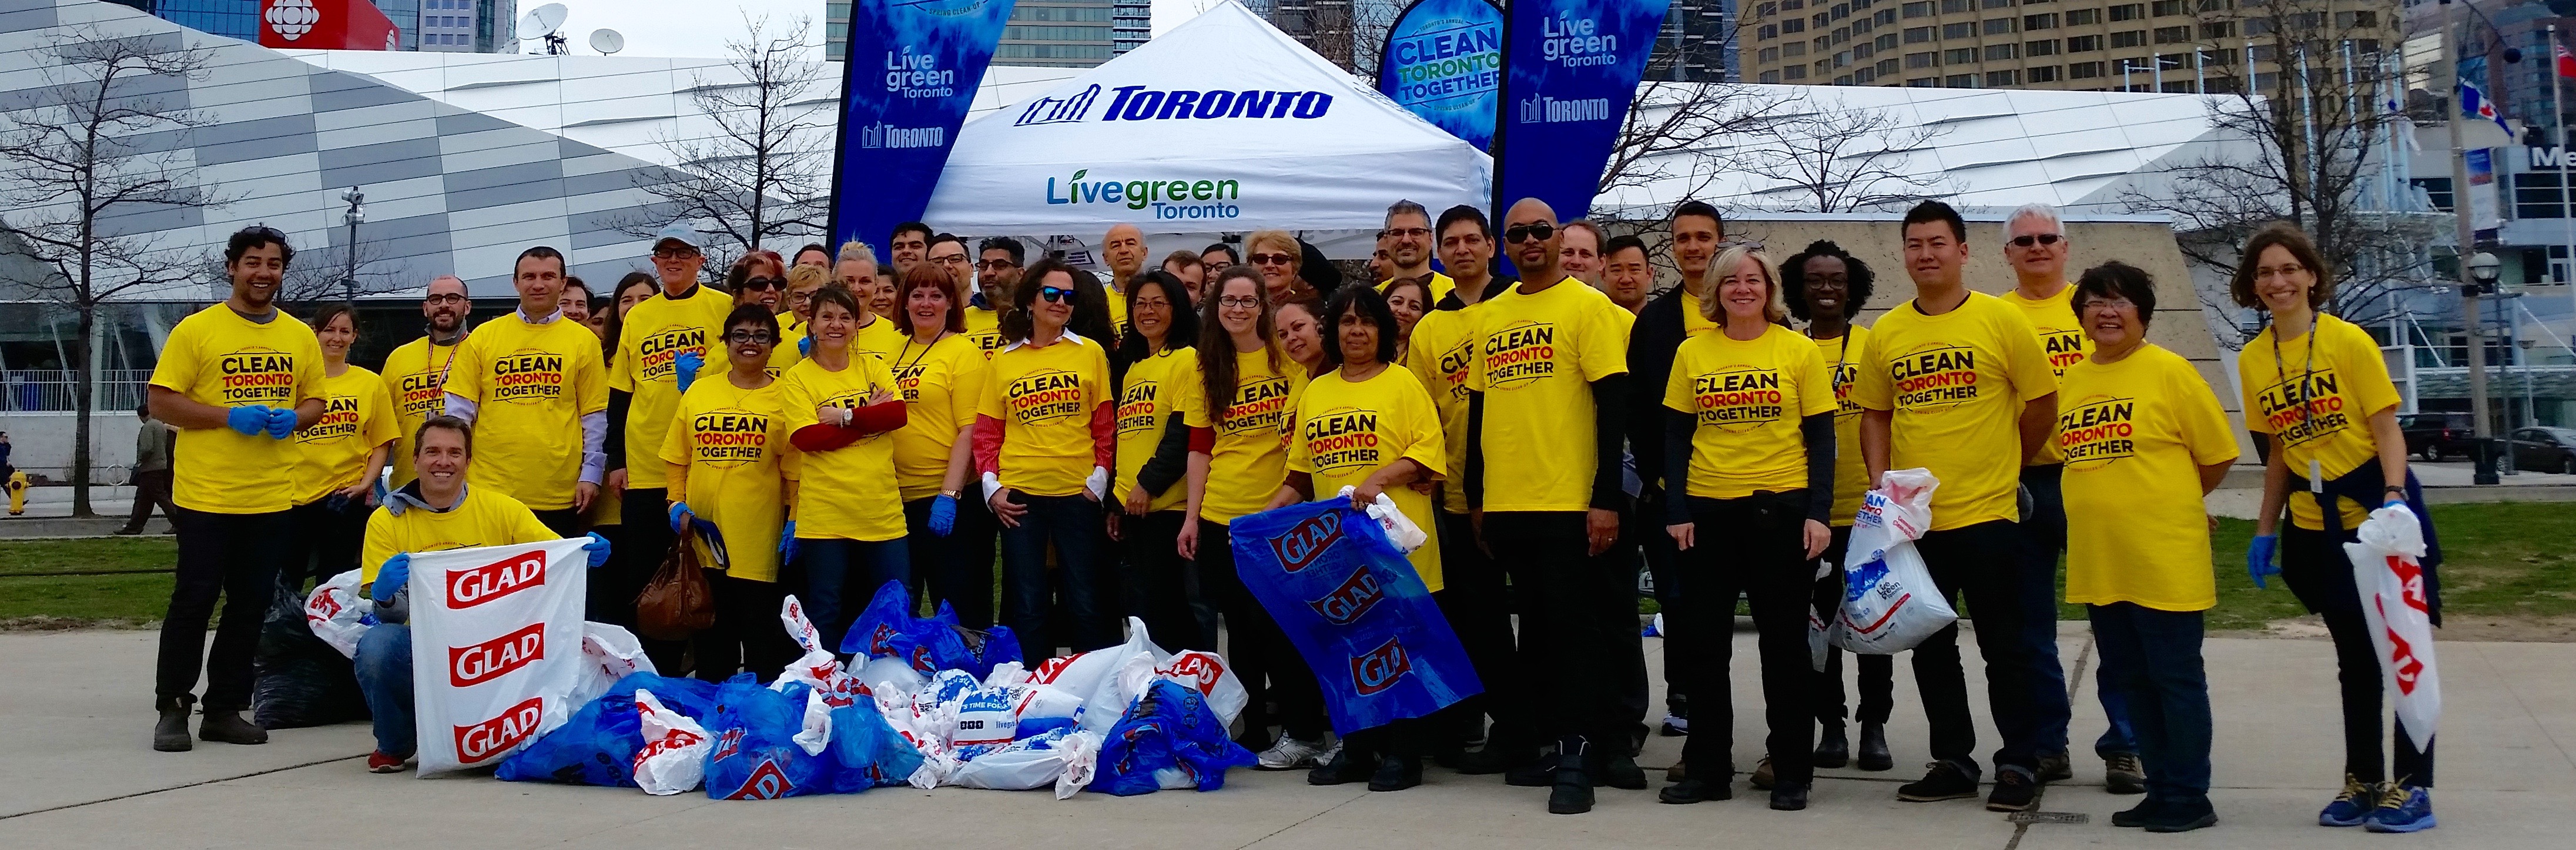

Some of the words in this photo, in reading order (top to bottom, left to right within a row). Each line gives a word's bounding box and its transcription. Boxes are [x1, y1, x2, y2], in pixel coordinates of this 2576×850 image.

[953, 2, 980, 15] CLEAN-UP
[1419, 19, 1445, 31] TORONTO'S
[1544, 9, 1594, 37] Live
[1396, 27, 1498, 65] CLEAN
[1543, 33, 1616, 61] green
[887, 45, 934, 70] Live
[1398, 52, 1500, 83] TORONTO
[1560, 53, 1616, 68] Toronto
[886, 69, 953, 92] green
[902, 87, 953, 98] Toronto
[1102, 85, 1334, 121] TORONTO
[1543, 96, 1609, 123] TORONTO
[885, 125, 943, 148] TORONTO
[1151, 202, 1240, 219] Toronto
[641, 331, 704, 355] CLEAN
[1485, 327, 1553, 355] CLEAN
[222, 357, 293, 374] CLEAN
[495, 357, 562, 375] CLEAN
[1486, 346, 1554, 370] TORONTO
[1892, 351, 1974, 381] CLEAN
[222, 374, 293, 387] TORONTO
[495, 372, 562, 386] TORONTO
[1487, 361, 1554, 383] TOGETHER
[1896, 371, 1977, 392] TORONTO
[223, 387, 291, 399] TOGETHER
[495, 384, 561, 397] TOGETHER
[1010, 374, 1079, 398] CLEAN
[1232, 381, 1289, 406] LEAN
[1696, 373, 1778, 395] CLEAN
[2260, 374, 2338, 416] CLEAN
[1011, 389, 1081, 411] TORONTO
[1121, 385, 1157, 406] LEAN
[1695, 390, 1781, 409] TORONTO
[1898, 385, 1978, 406] TOGETHER
[321, 412, 359, 424] ONTO
[1016, 402, 1080, 422] TOGETHER
[1699, 406, 1782, 422] TOGETHER
[2061, 402, 2133, 434] CLEAN
[2268, 397, 2343, 431] TORONTO
[695, 416, 768, 433] CLEAN
[1306, 414, 1376, 441] CLEAN
[2062, 423, 2132, 446] ORONTO
[2277, 413, 2348, 445] TOGETHER
[695, 433, 765, 445] TORONTO
[1308, 434, 1378, 455] TORONTO
[2063, 439, 2134, 461] OGETHER
[1312, 449, 1379, 468] TOGETHER
[1281, 510, 1339, 564] GLAD
[453, 559, 541, 602] GLAD
[1323, 573, 1379, 620] GLAD
[456, 633, 540, 680] GLAD
[461, 706, 538, 757] GLAD
